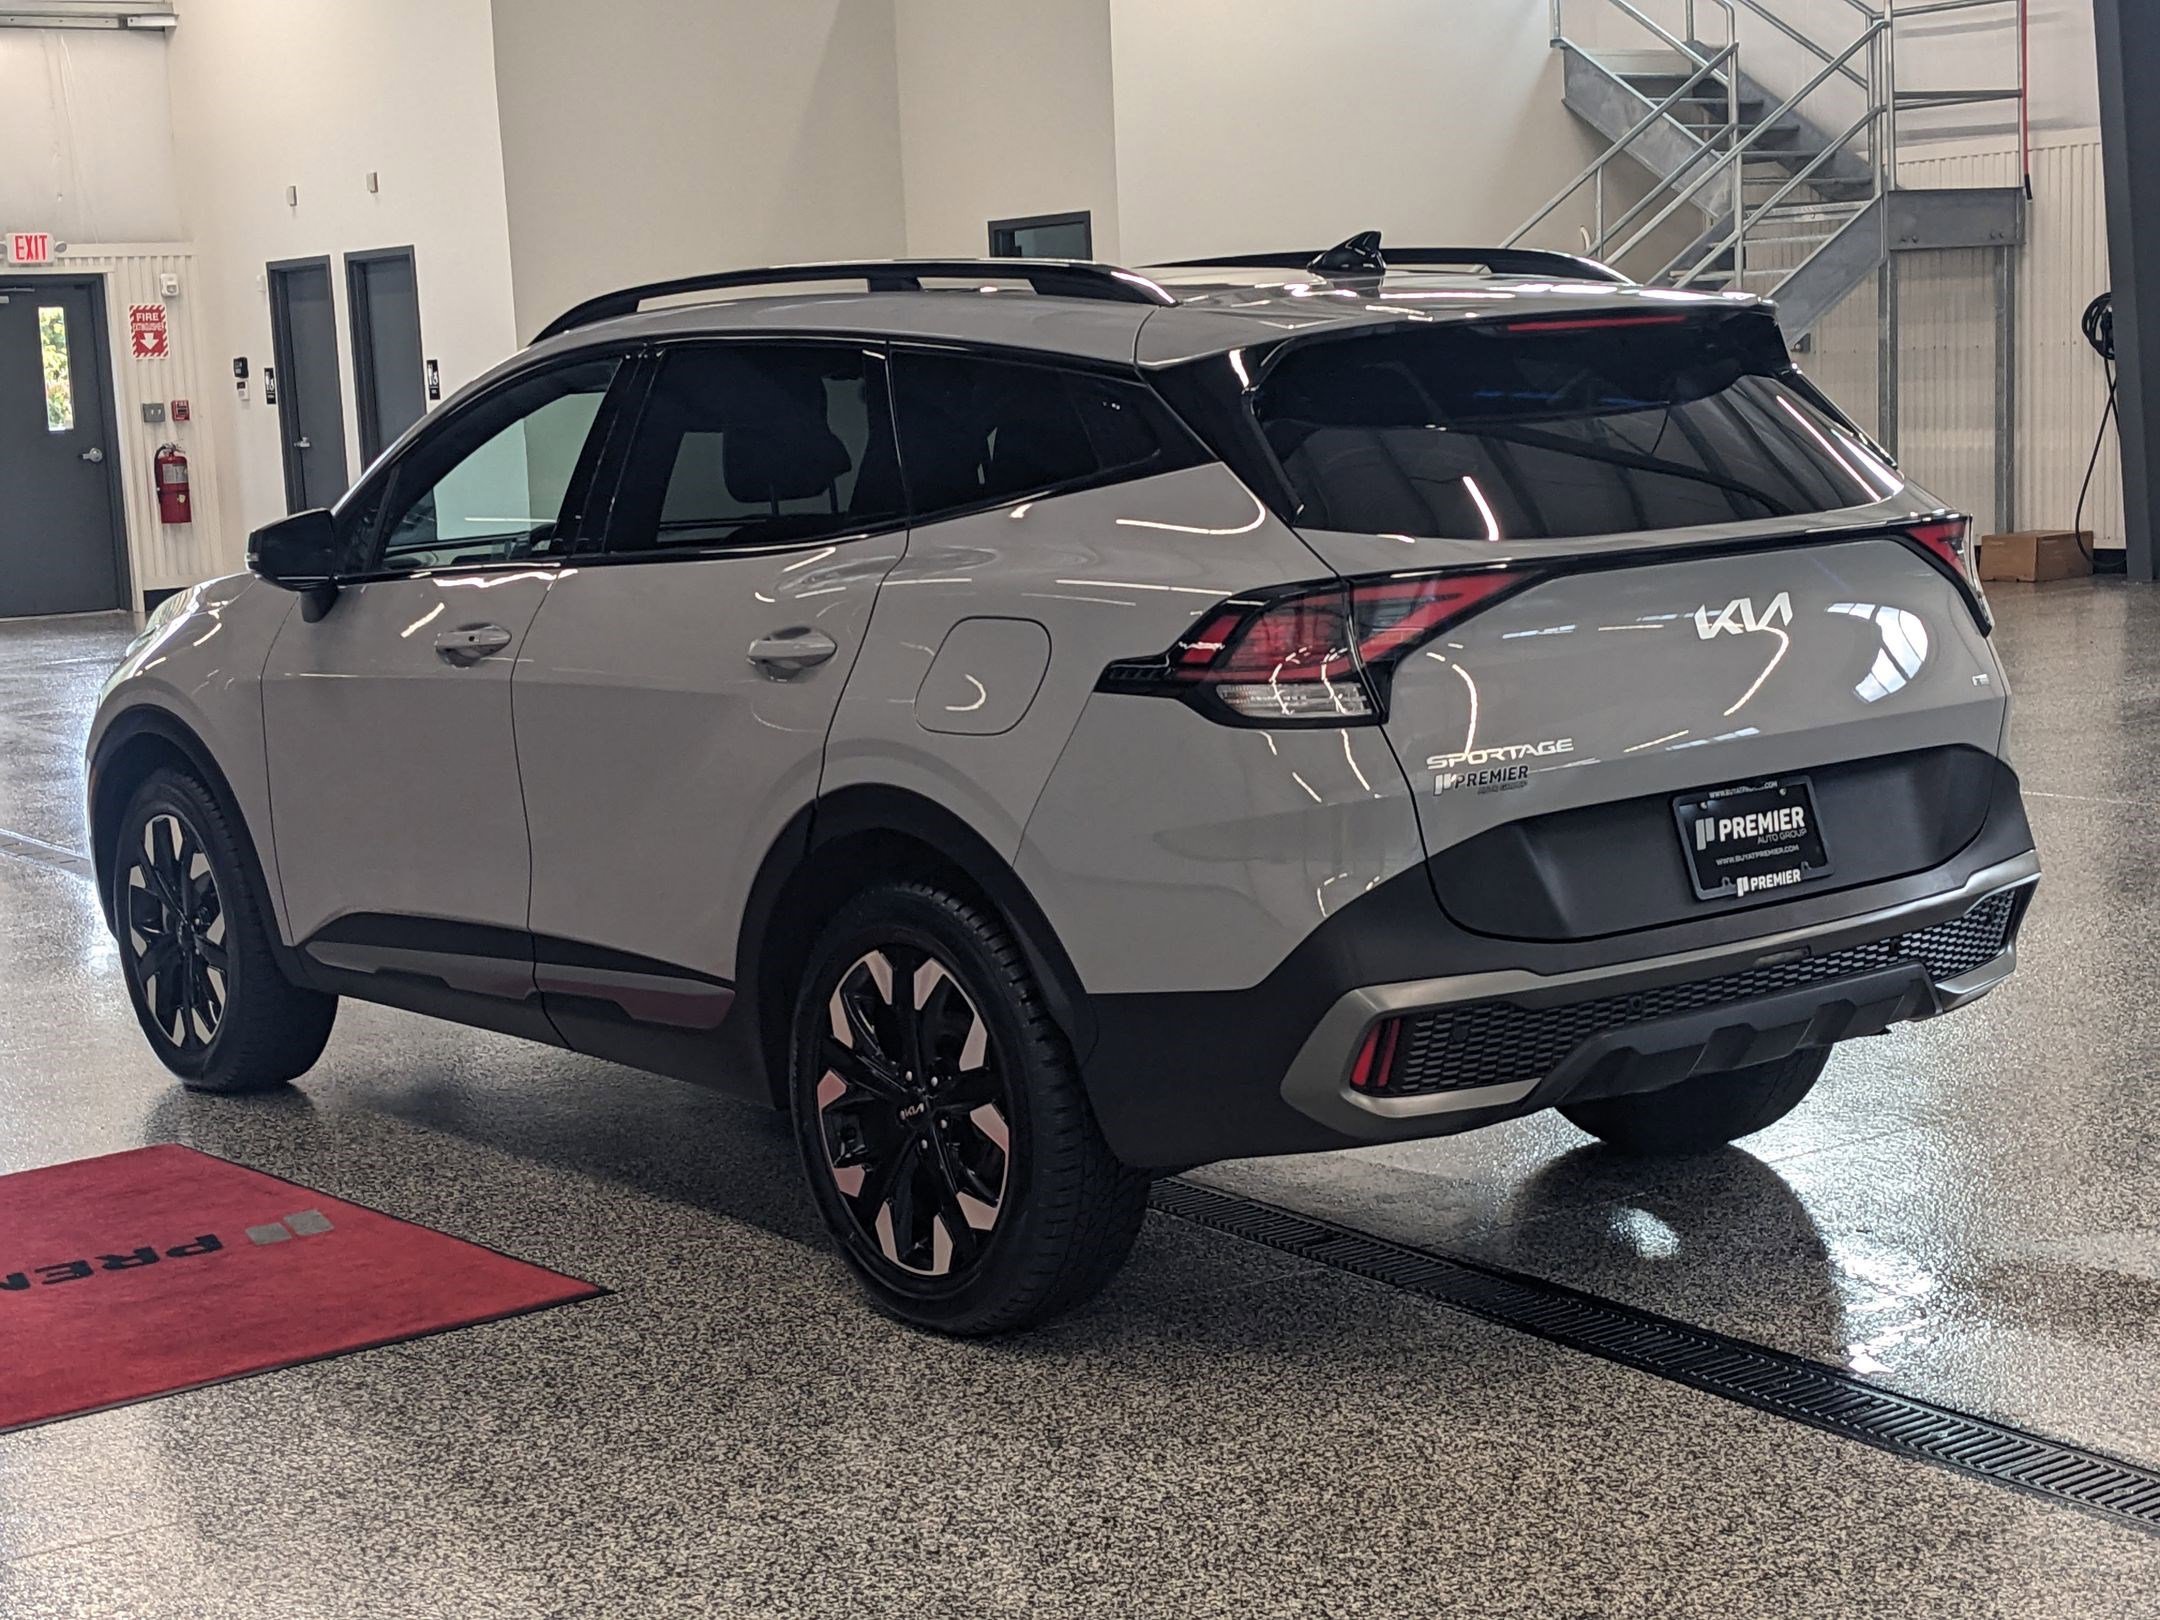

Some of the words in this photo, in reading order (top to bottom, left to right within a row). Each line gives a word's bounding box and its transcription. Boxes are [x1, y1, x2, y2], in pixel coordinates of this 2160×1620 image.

[15, 235, 47, 260] EXIT
[136, 312, 159, 321] FIRE
[1694, 592, 1793, 640] KIA
[1426, 738, 1574, 769] SPORTAGE
[1455, 765, 1529, 789] PREMIER
[1719, 806, 1805, 842] PREMIER
[1757, 833, 1779, 844] AUTO
[1779, 828, 1807, 841] GROUP
[1750, 868, 1801, 891] PREMIER
